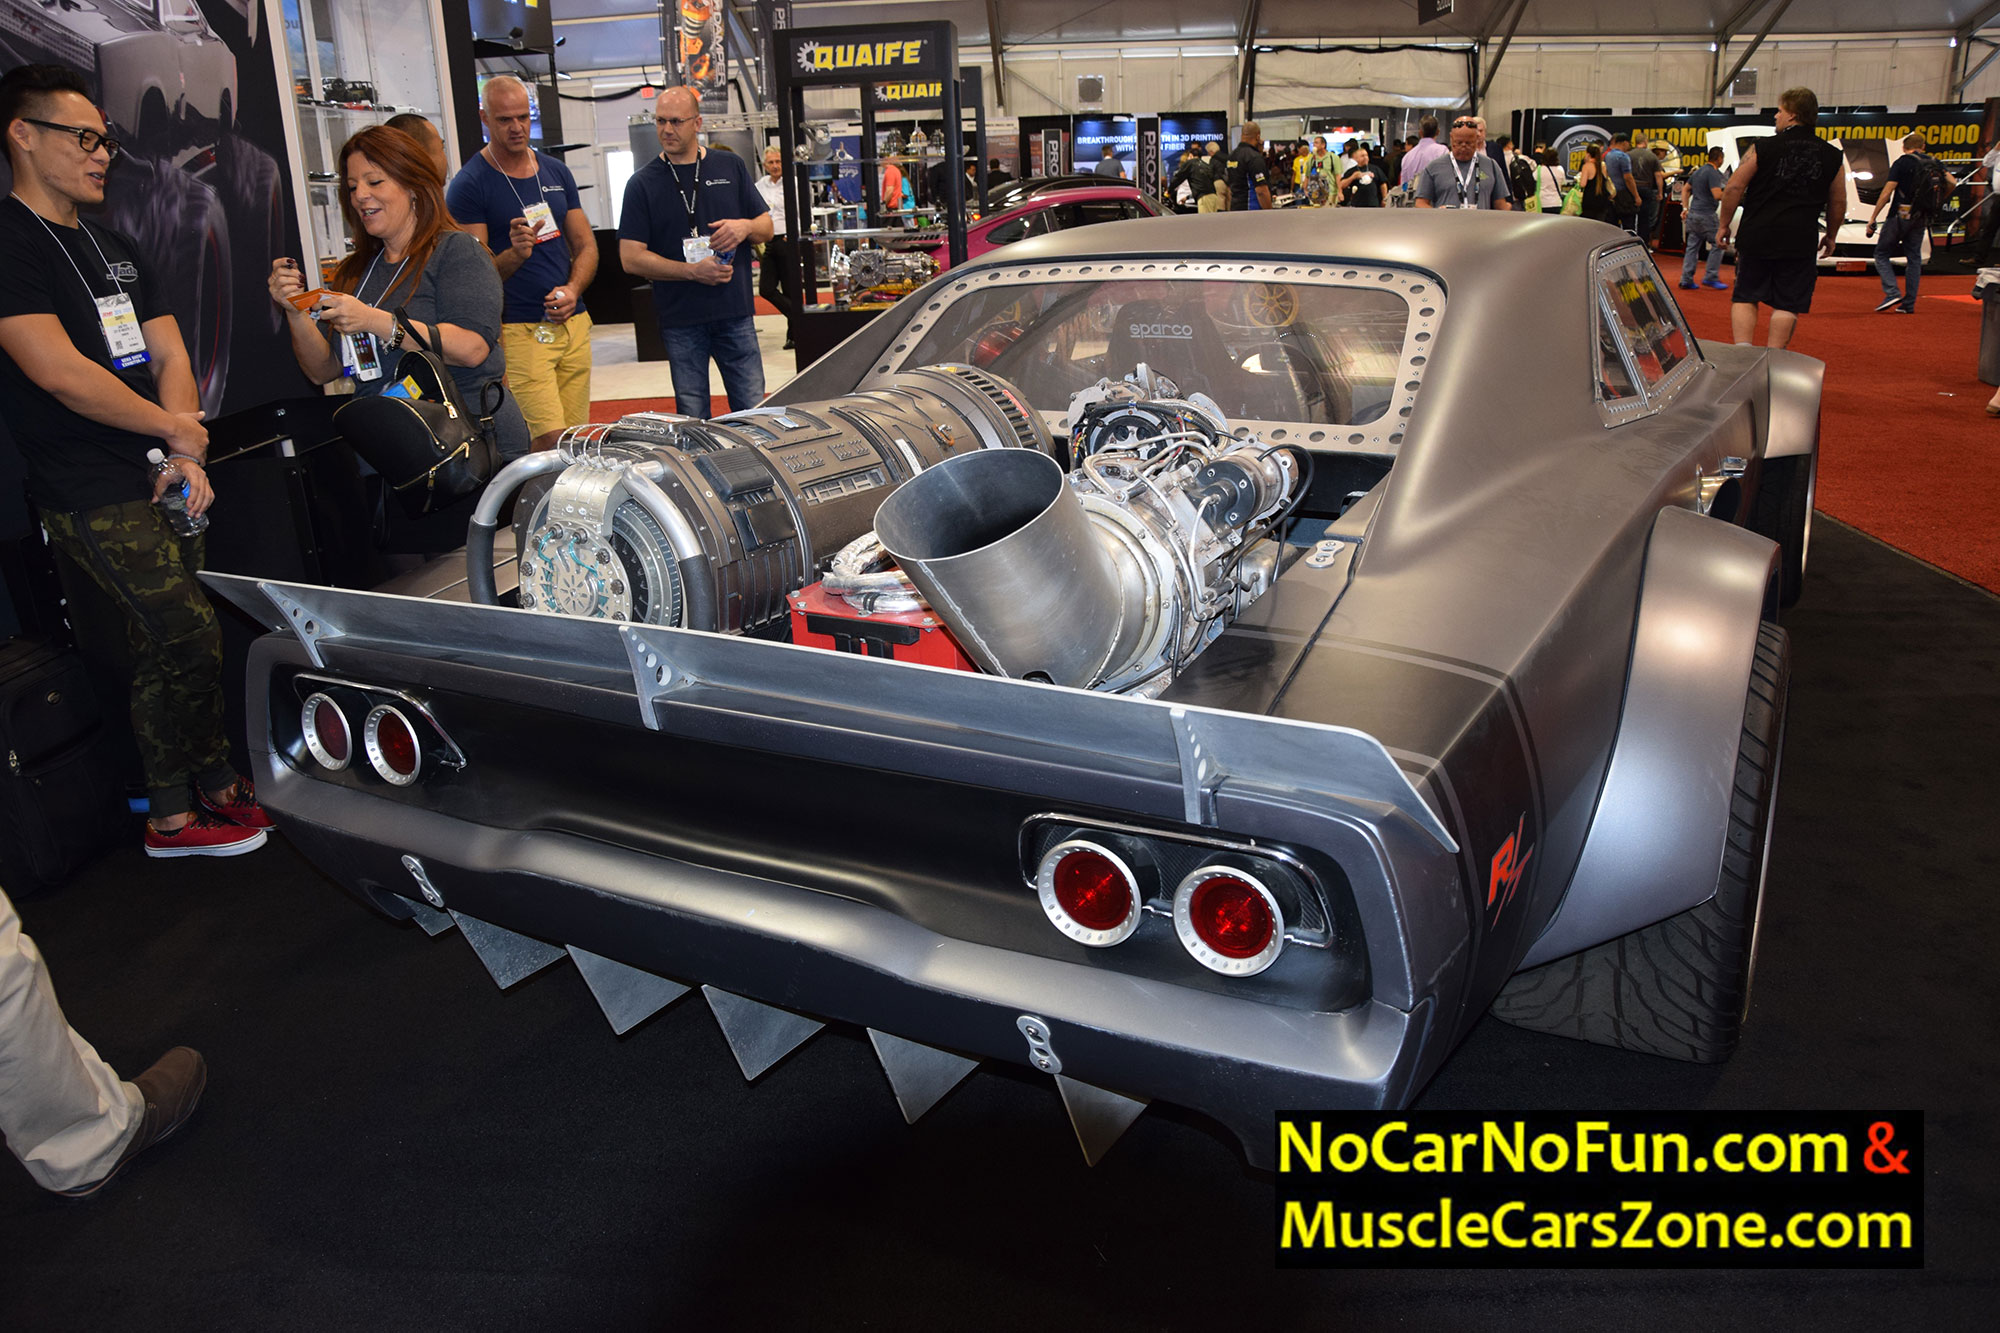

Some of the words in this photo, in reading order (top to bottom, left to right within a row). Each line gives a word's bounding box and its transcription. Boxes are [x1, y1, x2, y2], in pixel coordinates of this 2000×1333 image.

[814, 40, 922, 71] QUAIFE
[1077, 135, 1134, 145] BREAKTHROUGH
[1180, 134, 1190, 142] 3D
[1190, 133, 1224, 142] PRINTING
[1631, 127, 1710, 148] AUTOMO
[1815, 126, 1911, 142] DITIONING
[1914, 123, 1981, 145] SCHOO
[1115, 144, 1133, 152] WITH
[1164, 142, 1186, 150] FIBER
[1681, 152, 1709, 167] ools
[1129, 323, 1193, 339] sparco
